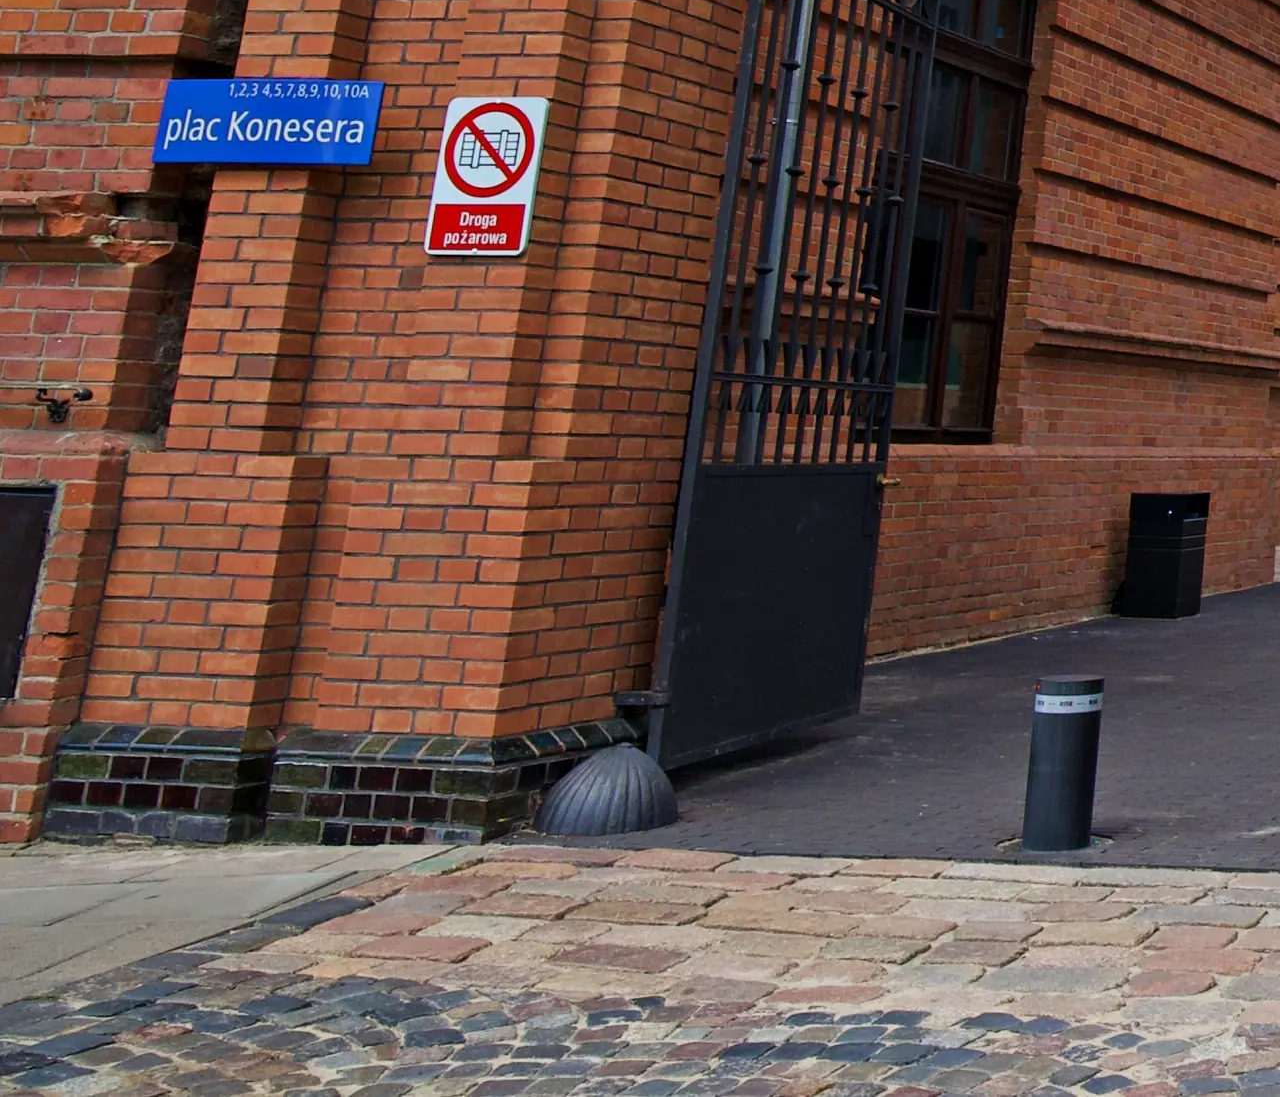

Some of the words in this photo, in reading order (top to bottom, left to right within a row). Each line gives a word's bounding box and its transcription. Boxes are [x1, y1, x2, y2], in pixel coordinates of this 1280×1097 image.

[163, 109, 221, 150] plac
[227, 110, 365, 144] Konesera
[459, 211, 498, 228] Droga
[443, 230, 508, 247] pożarowa
